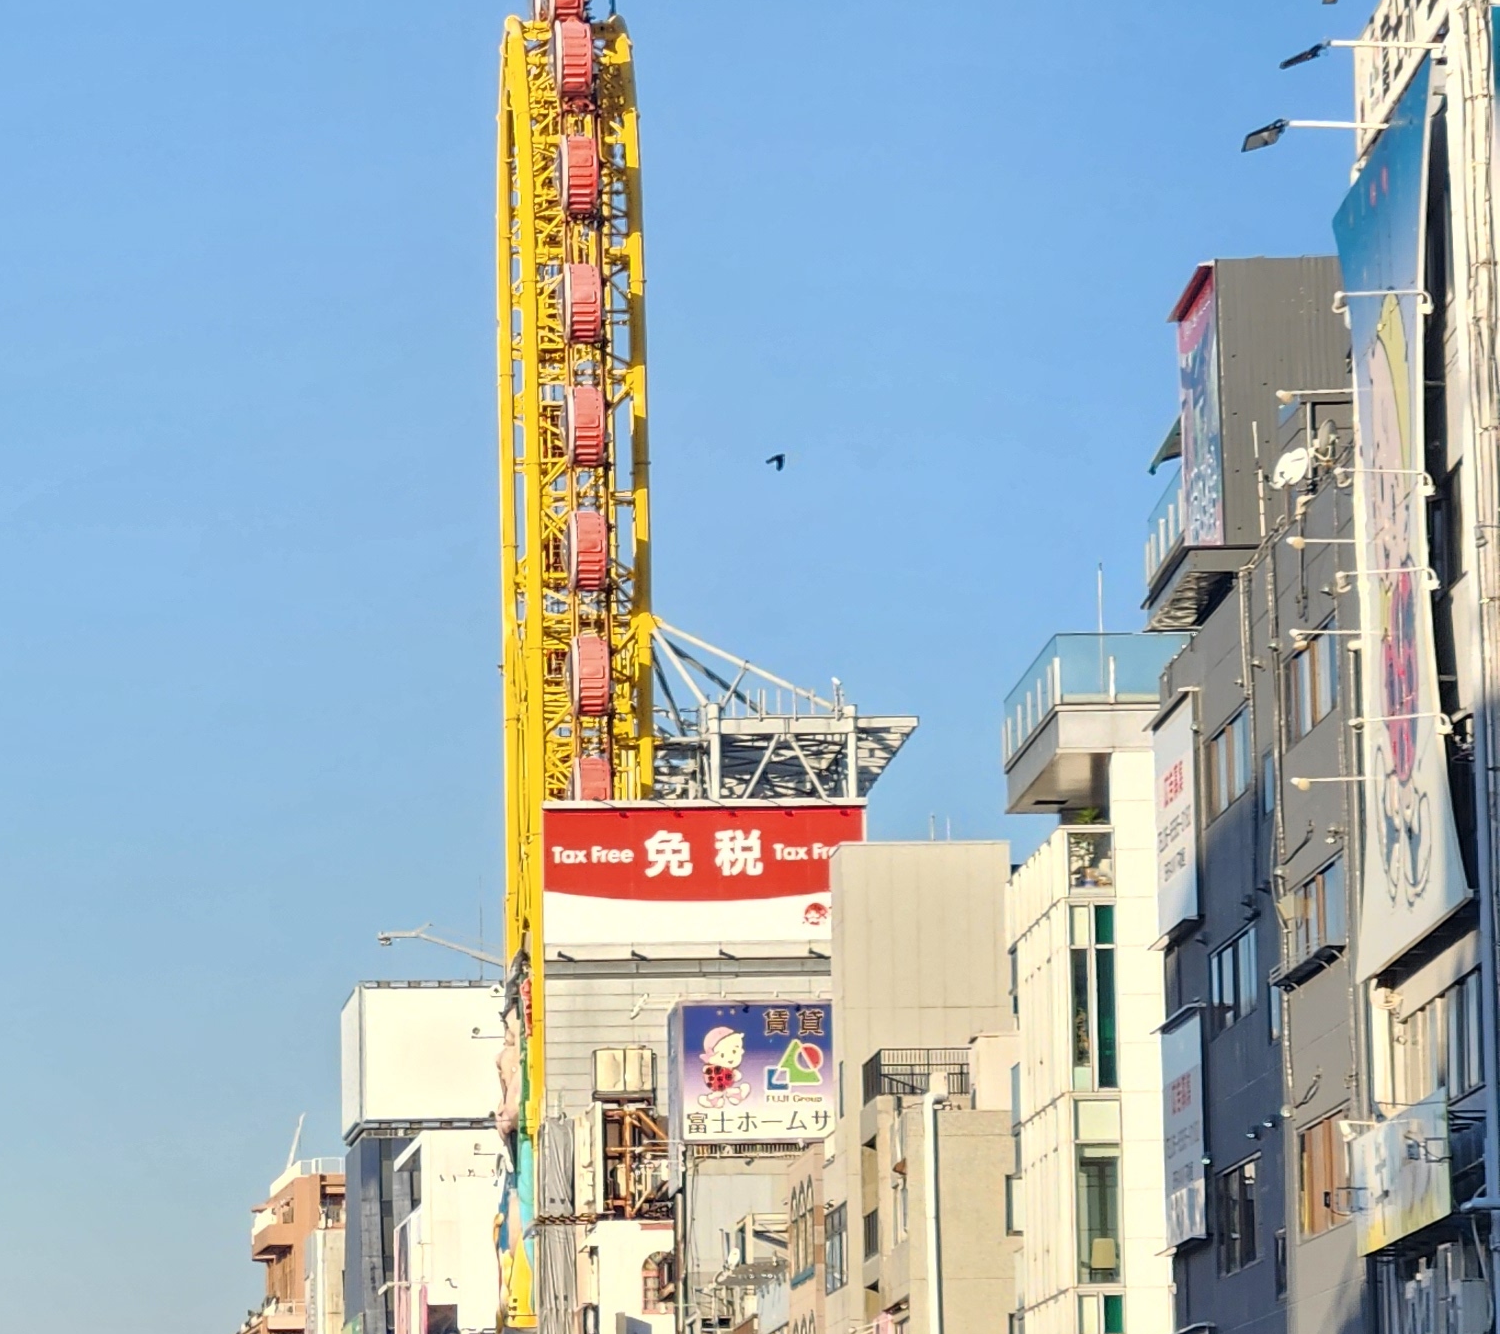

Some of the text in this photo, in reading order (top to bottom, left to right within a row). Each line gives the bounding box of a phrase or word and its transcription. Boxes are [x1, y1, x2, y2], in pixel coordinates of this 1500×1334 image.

[551, 846, 635, 865] Tax Free
[644, 829, 764, 878] 免税
[773, 843, 809, 860] Tax
[763, 1008, 825, 1036] 賃貸
[792, 1095, 824, 1104] Group
[686, 1110, 832, 1135] 富士ホームサ
